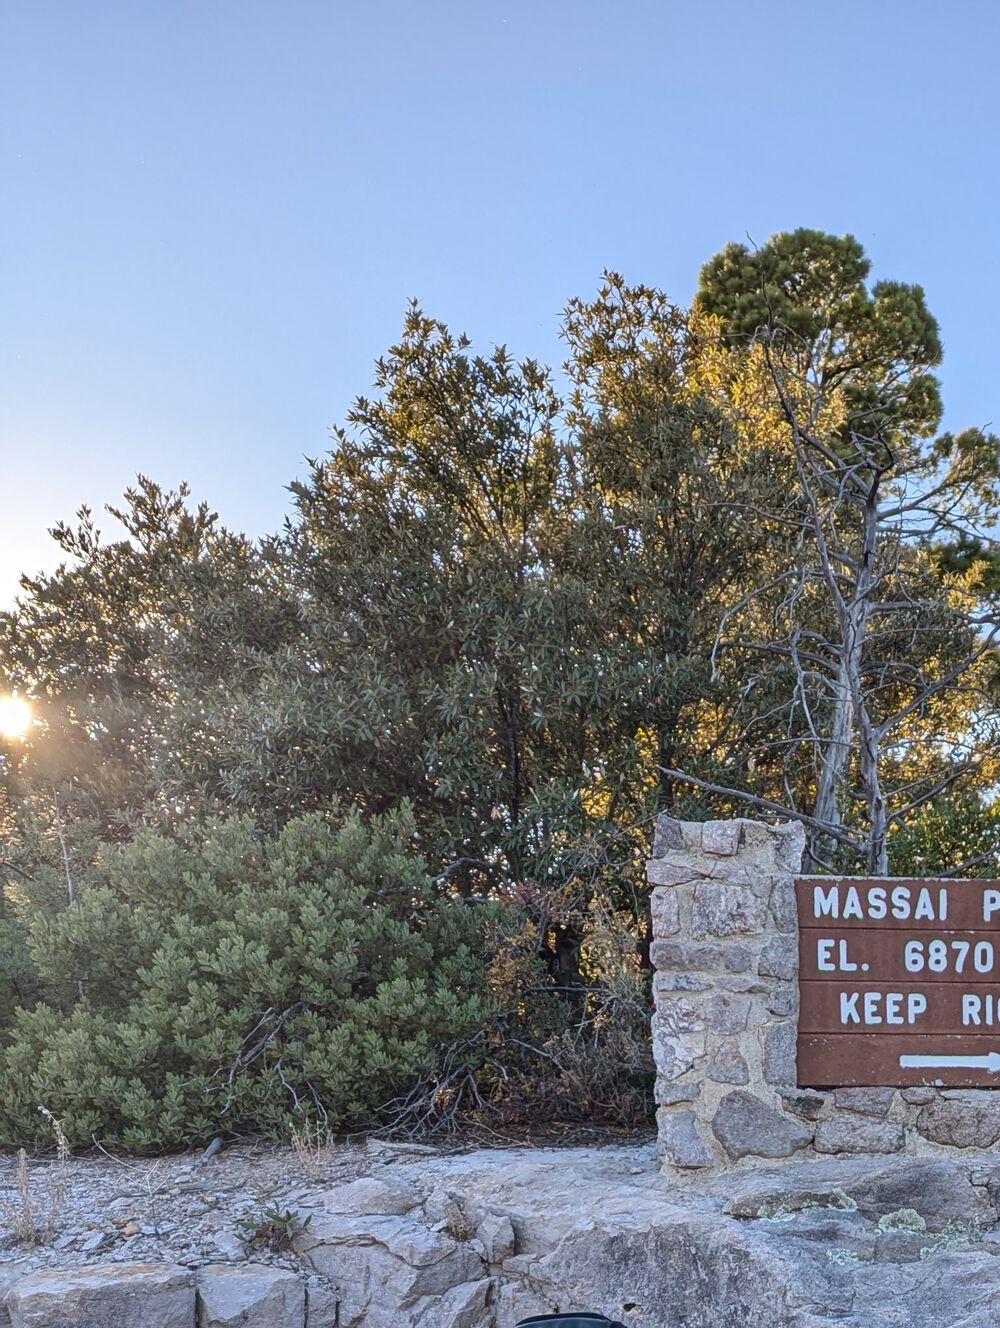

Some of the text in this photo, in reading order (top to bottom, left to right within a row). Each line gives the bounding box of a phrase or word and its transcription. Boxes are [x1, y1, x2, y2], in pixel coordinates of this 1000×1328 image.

[813, 886, 948, 921] MASSAI
[817, 938, 870, 972] EL.
[904, 939, 994, 974] 6870
[840, 992, 927, 1024] KEEP
